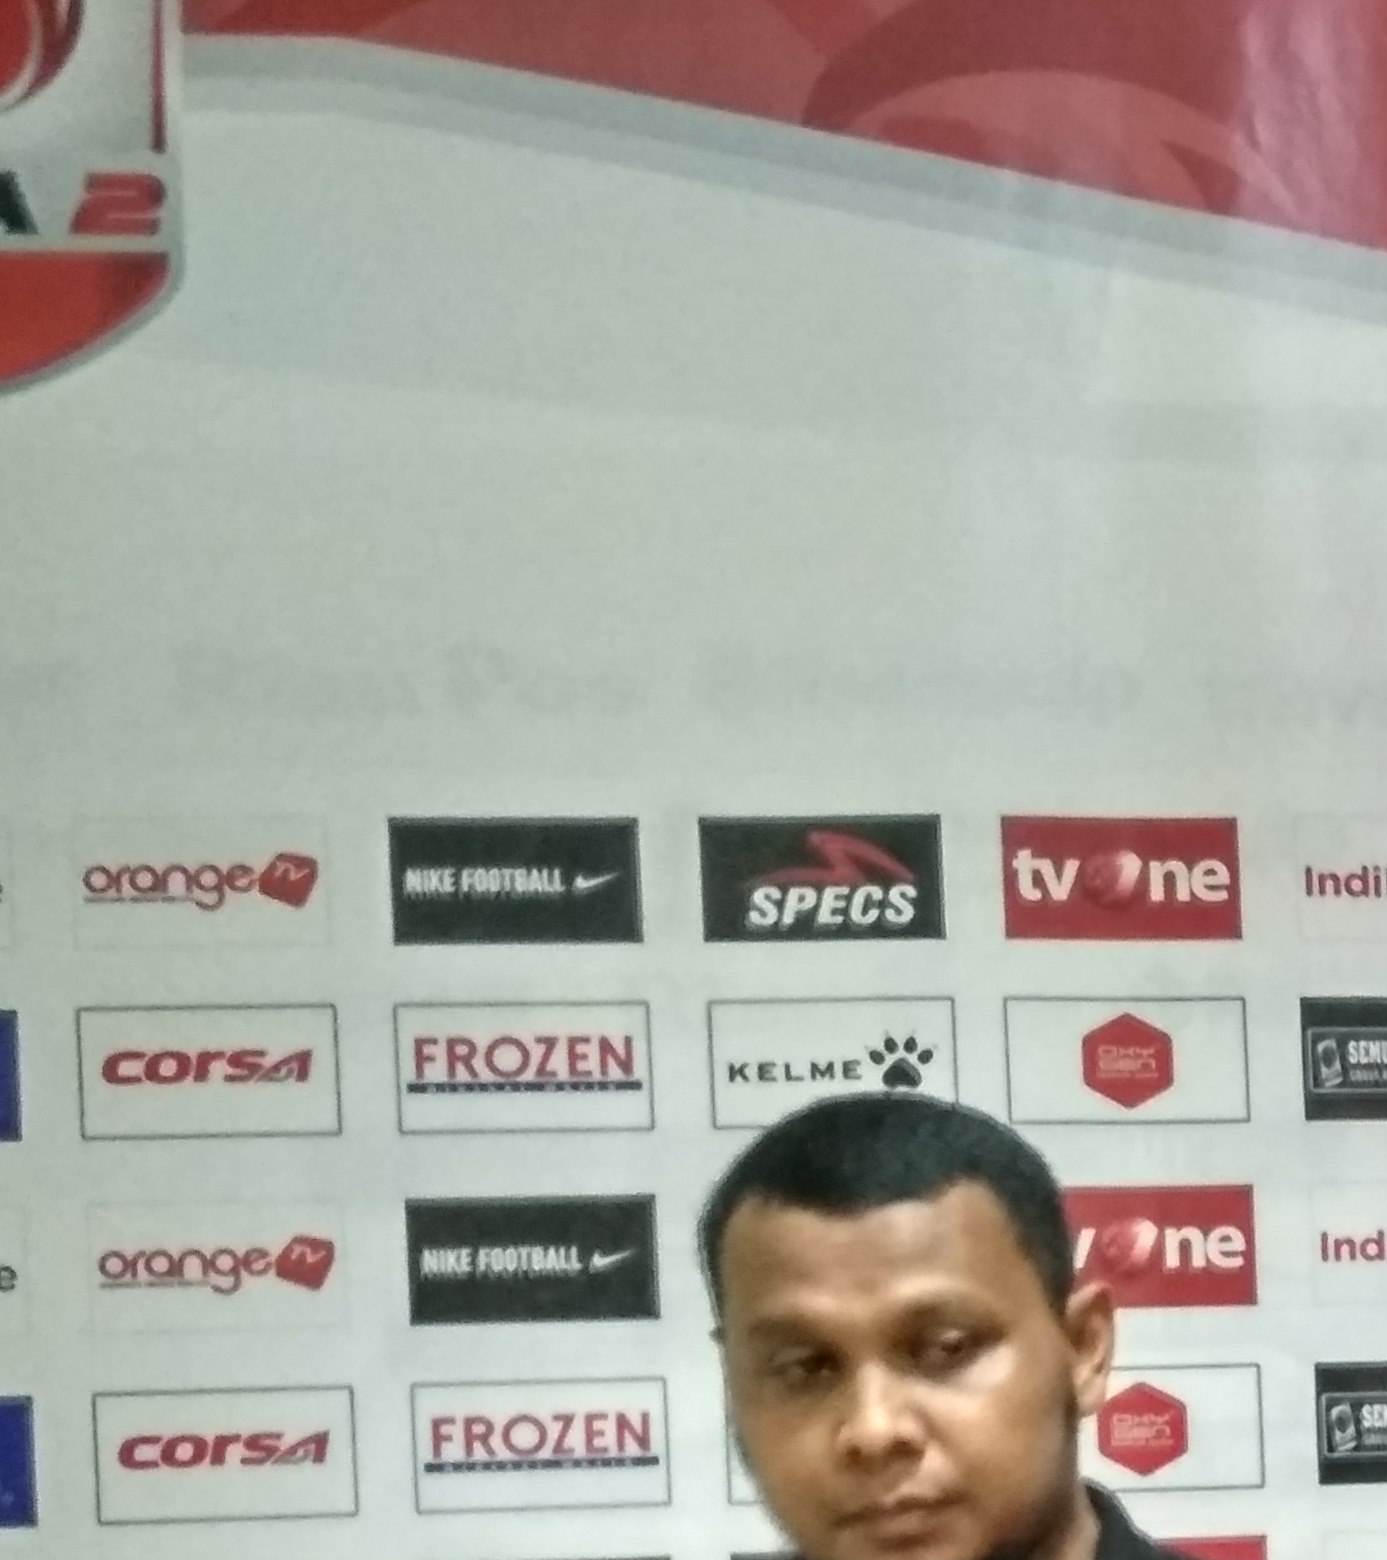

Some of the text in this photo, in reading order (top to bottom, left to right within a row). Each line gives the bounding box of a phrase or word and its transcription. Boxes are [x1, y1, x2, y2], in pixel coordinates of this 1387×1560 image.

[83, 863, 260, 911] orange
[406, 866, 566, 894] NIKE FOOTBALL
[1012, 846, 1231, 904] tvOne
[745, 884, 918, 928] SPECS
[414, 1035, 634, 1080] FROZEN
[728, 1060, 863, 1084] KELME
[100, 1246, 275, 1294] orange
[421, 1244, 581, 1277] NIKE FOOTBALL
[431, 1412, 650, 1459] FROZEN
